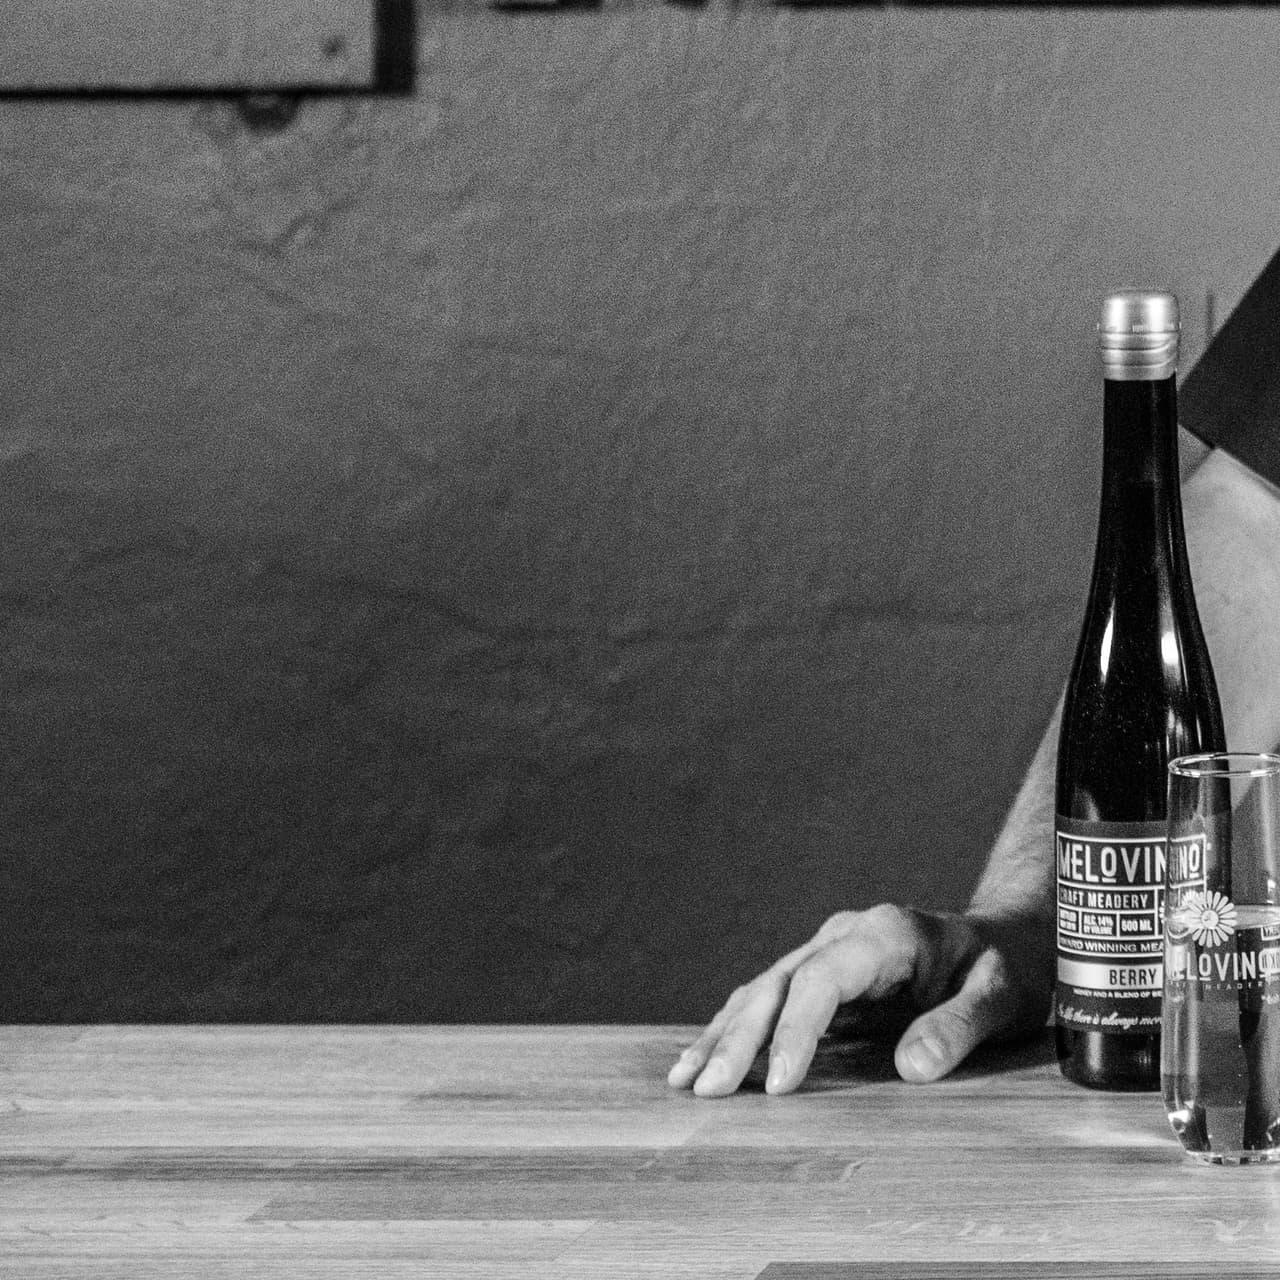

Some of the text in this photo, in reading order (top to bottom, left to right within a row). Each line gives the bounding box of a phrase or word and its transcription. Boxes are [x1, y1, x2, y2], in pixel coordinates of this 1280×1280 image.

[1087, 891, 1149, 909] MEADERY
[1139, 919, 1153, 932] ML
[1084, 940, 1137, 952] WINNING
[1109, 969, 1156, 986] BERRY
